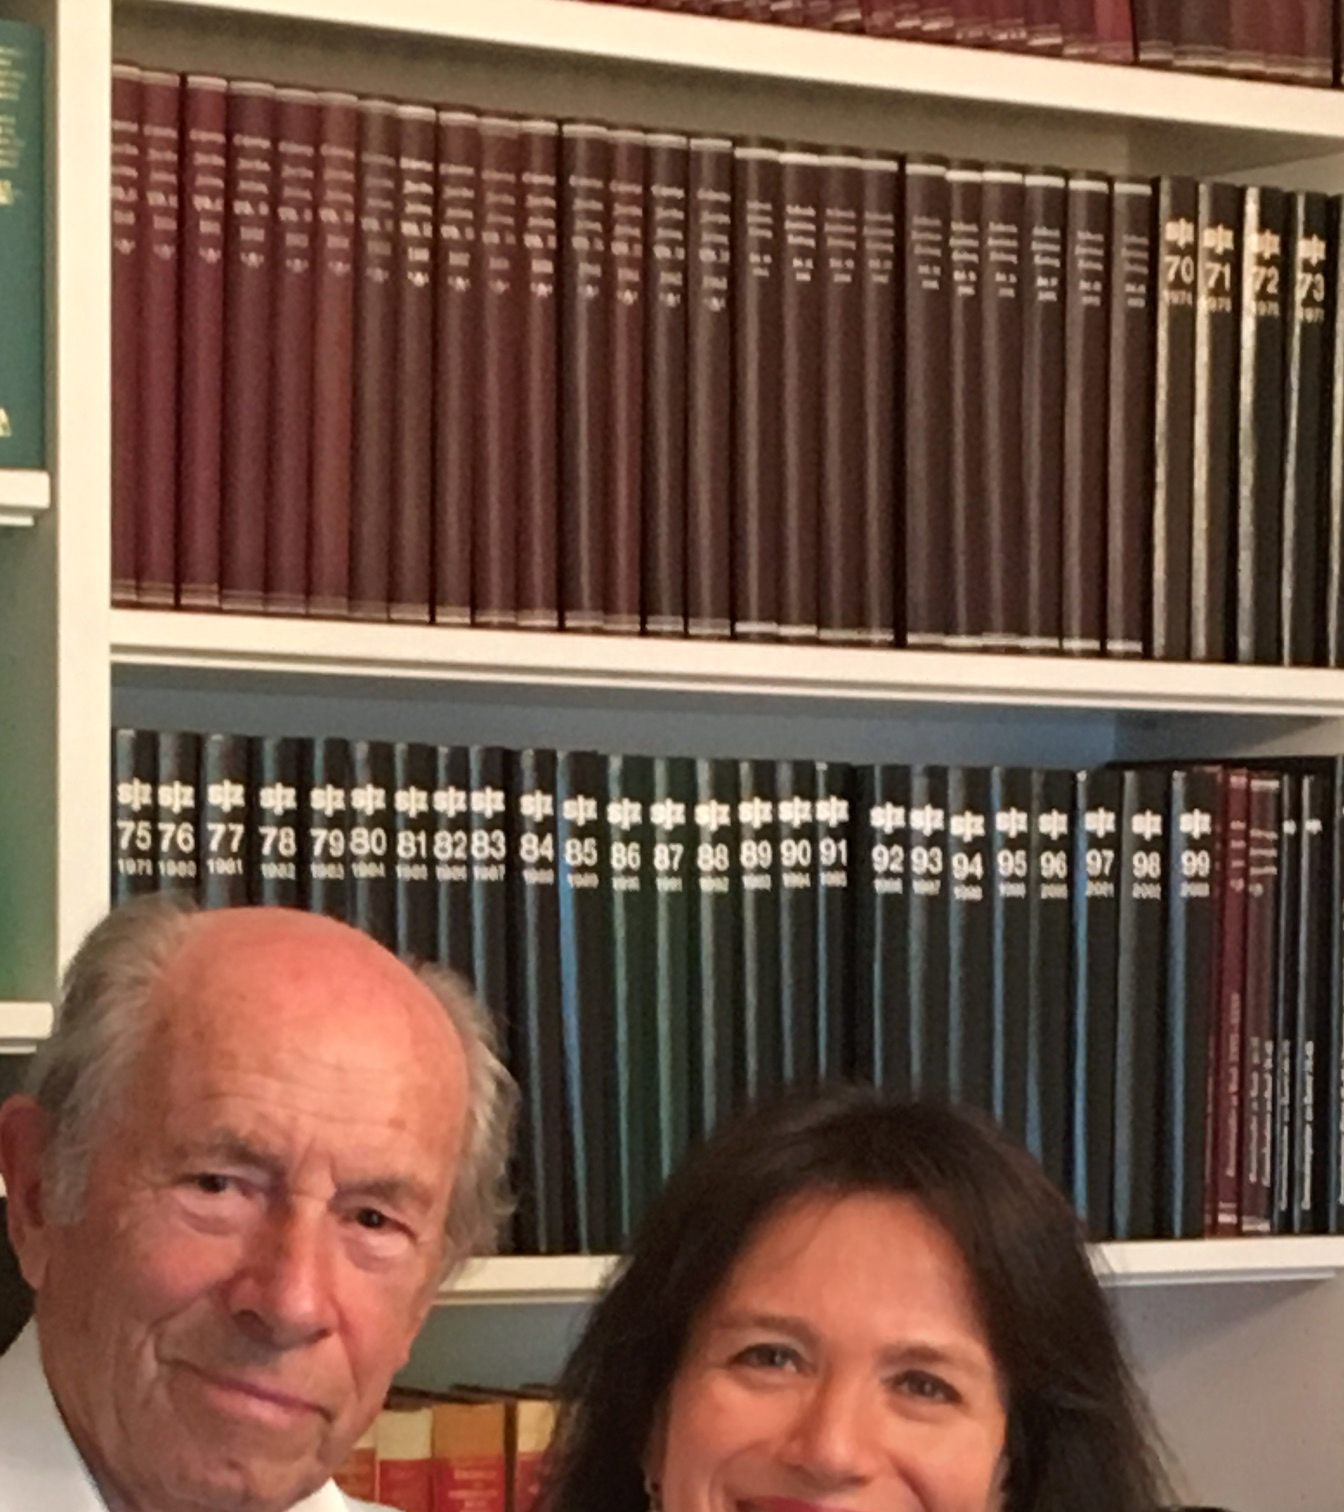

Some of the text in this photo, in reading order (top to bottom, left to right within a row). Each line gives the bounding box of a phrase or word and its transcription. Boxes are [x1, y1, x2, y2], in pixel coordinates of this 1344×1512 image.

[1163, 255, 1194, 284] 70
[1205, 262, 1231, 292] 71
[1251, 265, 1280, 295] 72
[1296, 272, 1325, 303] 73
[117, 820, 151, 850] 75
[158, 822, 195, 853] 76
[207, 823, 244, 852] 77
[259, 826, 297, 857] 78
[310, 828, 344, 857] 79
[350, 827, 387, 856] 80
[397, 830, 426, 859] 81
[433, 830, 467, 860] 82
[471, 829, 505, 860] 83
[520, 832, 553, 863] 84
[565, 838, 597, 866] 85
[611, 841, 641, 870] 86
[654, 843, 683, 871] 87
[698, 843, 729, 872] 88
[740, 839, 773, 869] 89
[780, 839, 811, 867] 90
[819, 838, 848, 867] 91
[872, 843, 904, 874] 92
[910, 846, 943, 875] 93
[952, 852, 984, 881] 94
[997, 849, 1027, 877] 95
[1040, 851, 1068, 879] 96
[1085, 849, 1114, 876] 97
[1132, 851, 1161, 879] 98
[1181, 850, 1211, 878] 99
